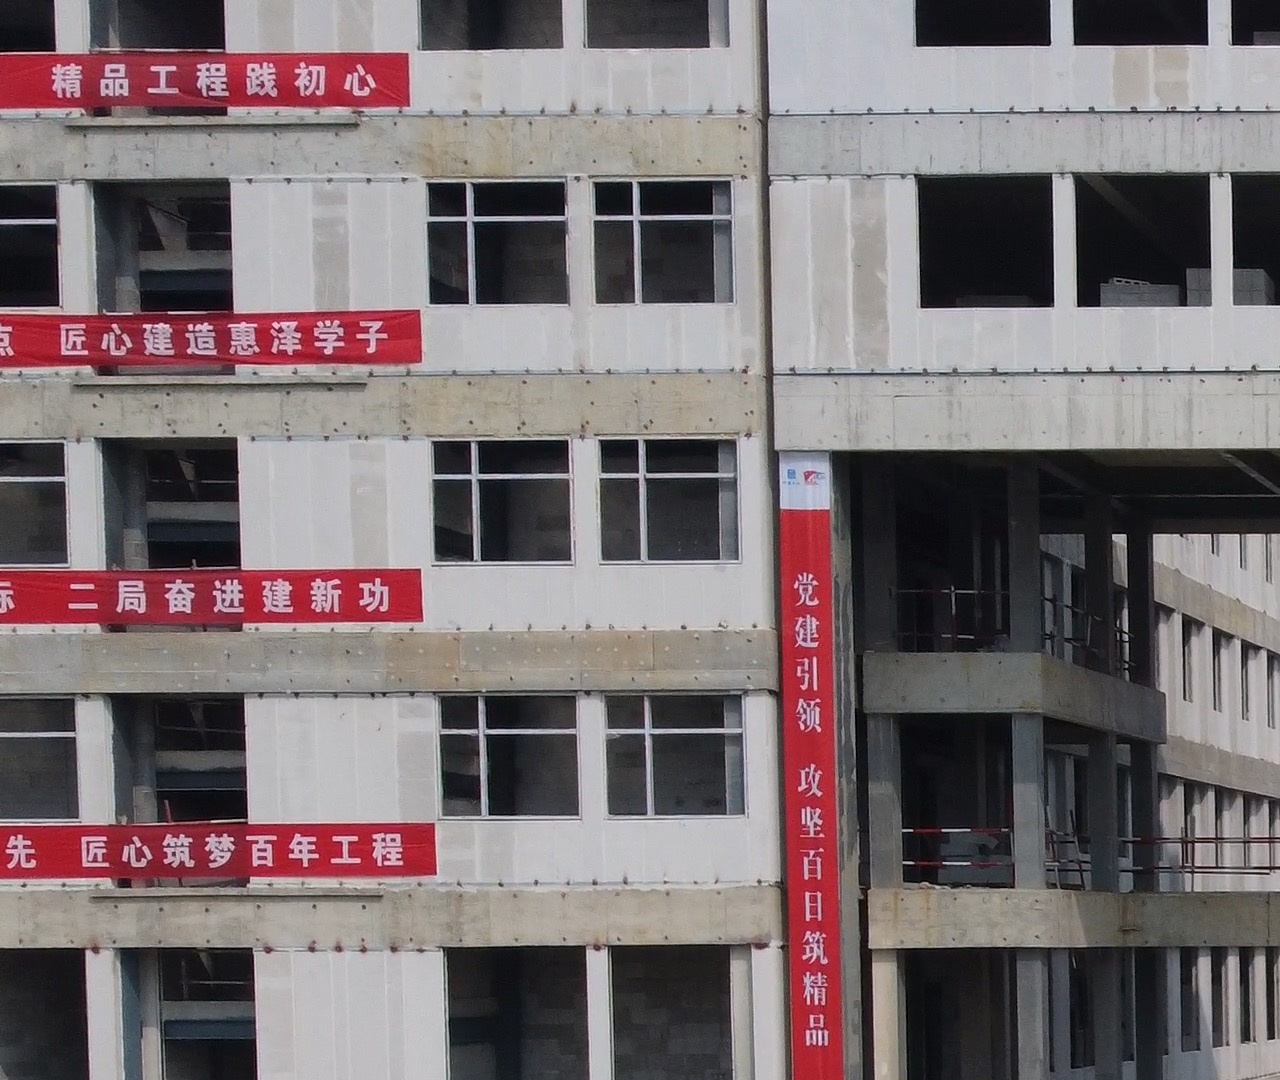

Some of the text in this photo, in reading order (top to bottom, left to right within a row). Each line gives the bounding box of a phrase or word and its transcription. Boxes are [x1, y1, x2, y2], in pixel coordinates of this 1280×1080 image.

[51, 62, 377, 98] 精品工程践初心
[60, 321, 389, 357] 匠心建造惠泽学子
[68, 578, 390, 615] 二局奋进建新功
[793, 572, 829, 1047] 党建引领 攻坚百日筑精品
[81, 834, 405, 869] 匠心筑梦百年工程
